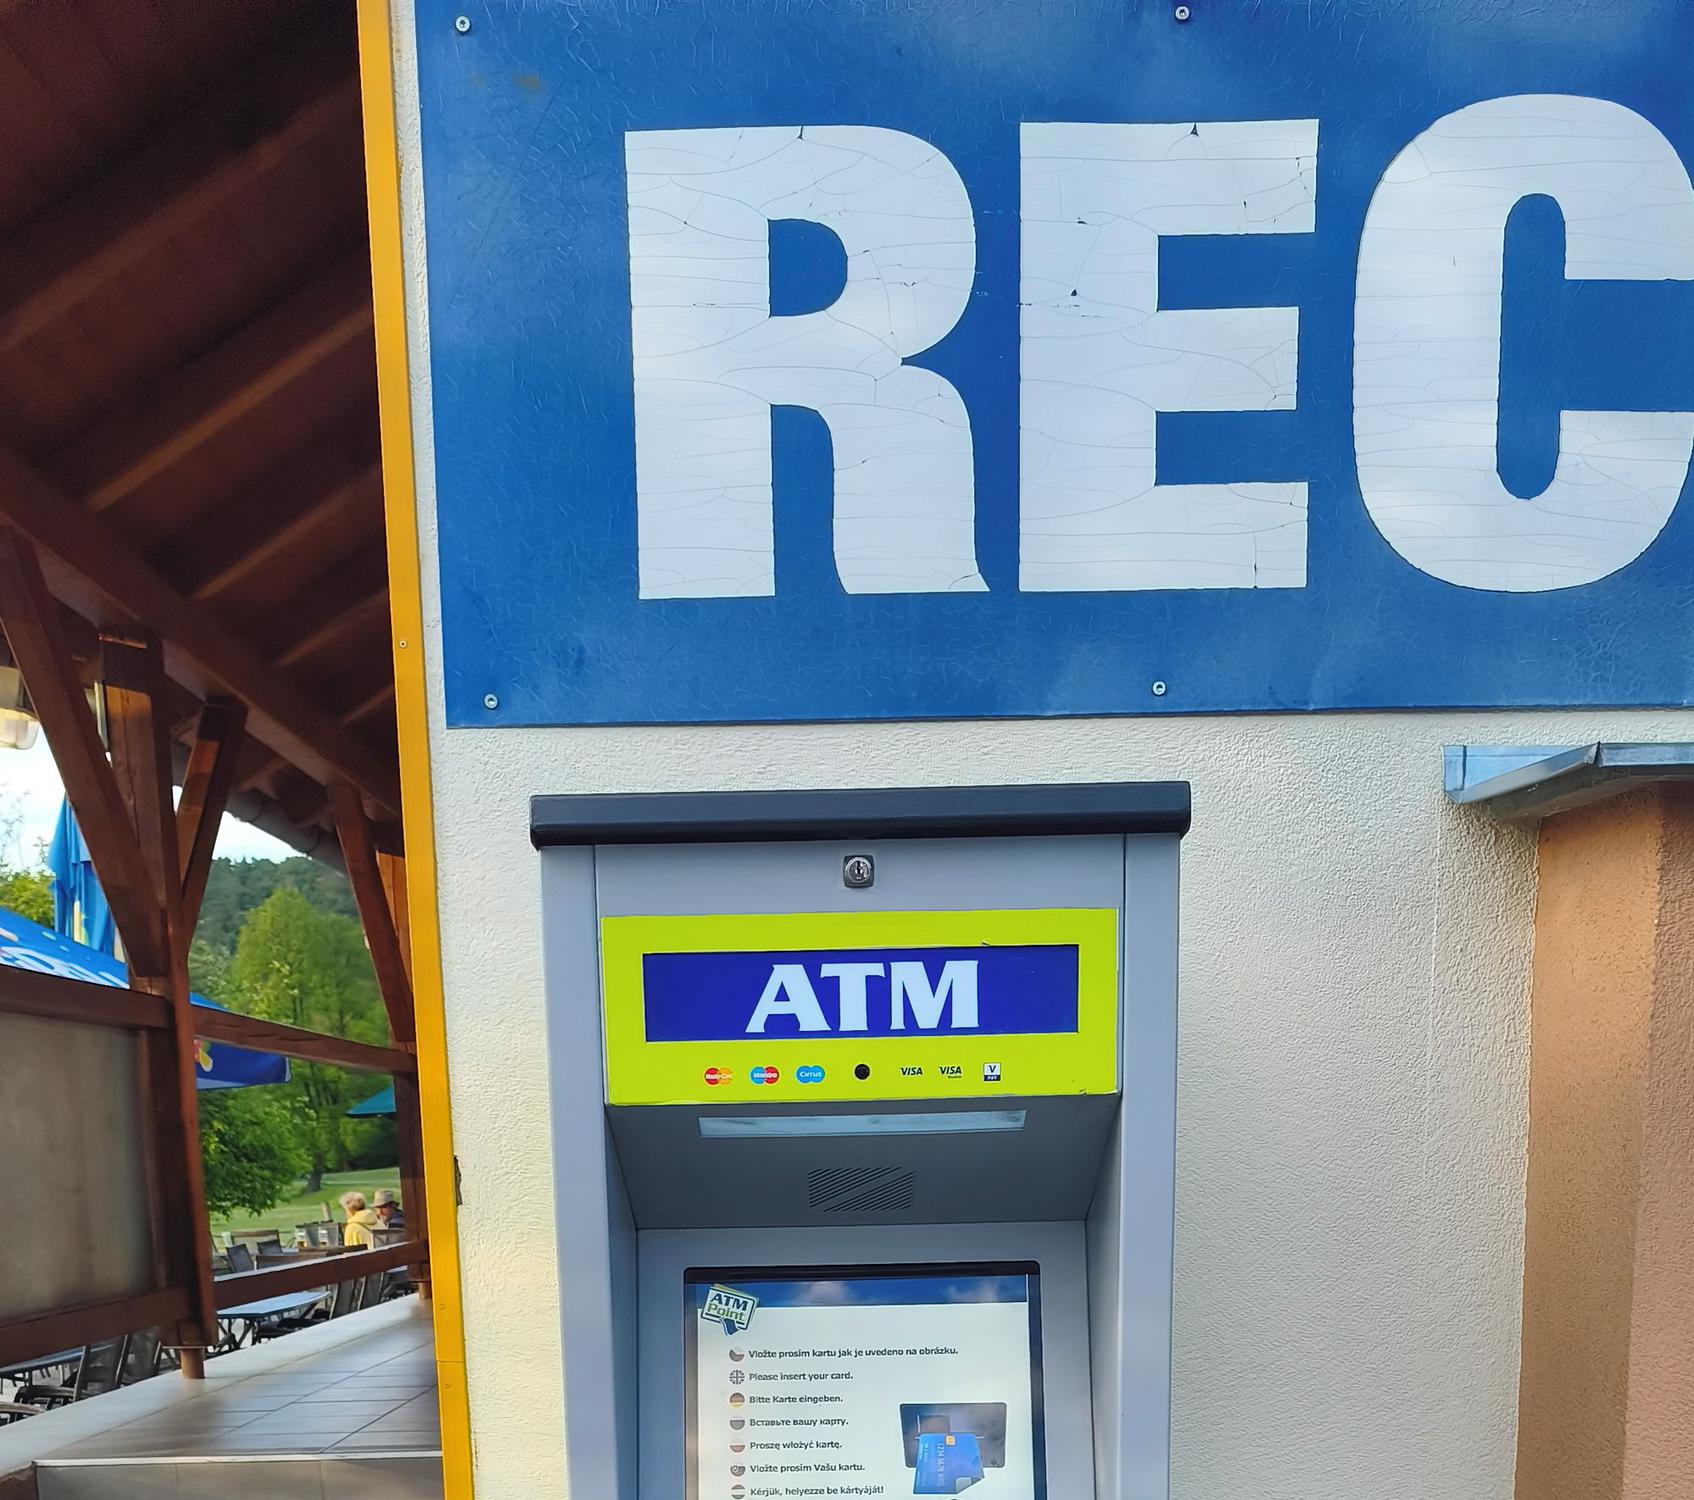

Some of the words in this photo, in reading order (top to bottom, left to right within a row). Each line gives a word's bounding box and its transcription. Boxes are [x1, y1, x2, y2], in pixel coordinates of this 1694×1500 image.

[745, 960, 980, 1033] ATM
[799, 1070, 822, 1078] Cirrus
[900, 1067, 923, 1076] VISA
[939, 1066, 962, 1075] VISA
[709, 1292, 749, 1312] ATM
[706, 1302, 746, 1321] Point
[749, 1349, 777, 1359] Vložte
[812, 1348, 837, 1358] kartu
[838, 1348, 853, 1359] jak
[854, 1348, 864, 1358] je
[865, 1347, 904, 1357] uvedeno
[905, 1348, 918, 1356] na
[919, 1346, 959, 1356] obrázku.
[749, 1372, 779, 1382] Please
[780, 1372, 807, 1381] insert
[808, 1373, 830, 1383] your
[830, 1370, 854, 1380] card.
[749, 1395, 771, 1404] Bitte
[772, 1394, 798, 1404] Karte
[798, 1394, 844, 1406] eingeben.
[749, 1418, 791, 1427] Вставьте
[792, 1418, 818, 1428] вашу
[819, 1417, 849, 1428] карту.
[749, 1464, 779, 1473] Vložte
[813, 1463, 837, 1472] Vašu
[838, 1462, 866, 1472] kartu.
[784, 1486, 825, 1497] helyezze
[826, 1486, 839, 1495] be
